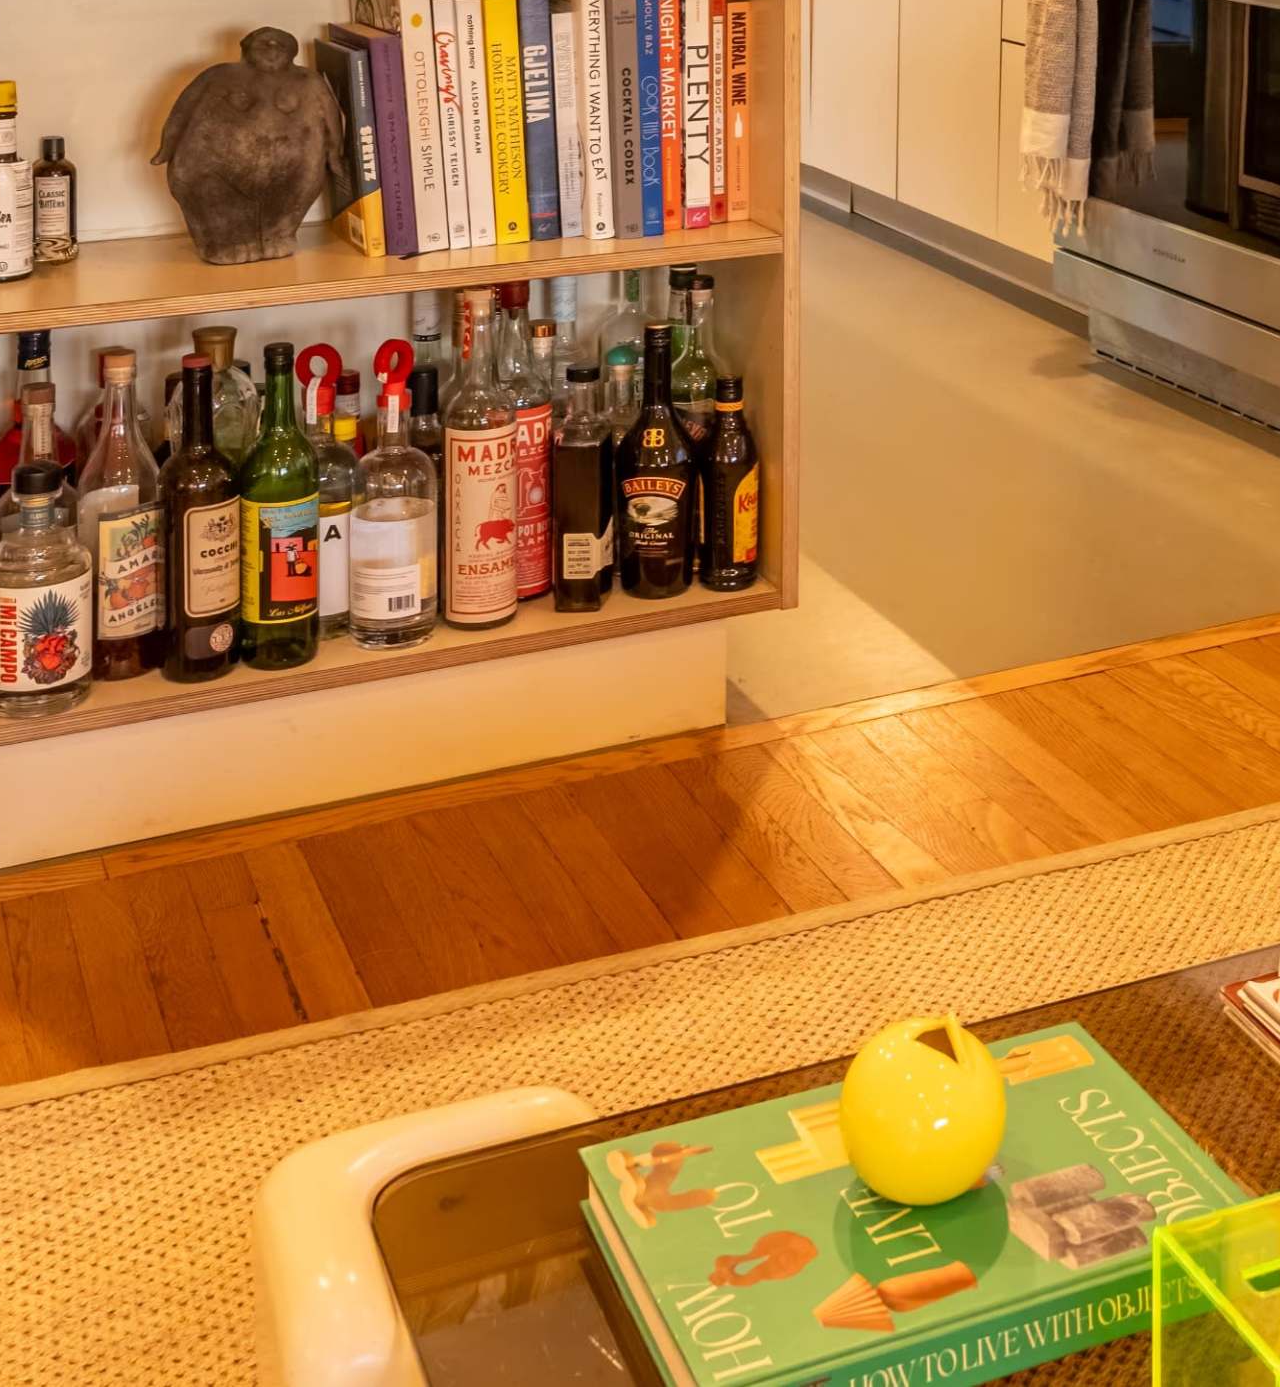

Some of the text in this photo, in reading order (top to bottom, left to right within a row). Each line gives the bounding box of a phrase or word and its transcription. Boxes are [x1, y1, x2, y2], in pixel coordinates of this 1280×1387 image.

[466, 14, 475, 45] nothing
[645, 35, 654, 55] BAZ
[664, 53, 671, 63] +
[523, 44, 551, 124] GJELINA
[731, 12, 747, 107] NATURAL WINE
[415, 51, 436, 192] OTTOLENGHI SIMPLE
[435, 31, 461, 187] Cravings CHRISSY TEIGEN
[471, 80, 482, 154] ALISON ROMAN
[491, 42, 510, 195] HOME STYLE COOKERY
[505, 55, 522, 179] MATTY MATHESON
[589, 92, 601, 134] WANT
[641, 75, 659, 116] COOK
[661, 67, 676, 141] MARKET
[687, 45, 710, 165] PLENTY
[360, 125, 377, 182] SPRITZ
[589, 137, 601, 155] TO
[622, 68, 635, 185] COCKTAIL CODEX
[642, 121, 659, 140] THIS
[715, 128, 723, 173] AMARO
[39, 190, 65, 199] CLASSIC
[387, 111, 399, 174] SNACKY
[394, 181, 404, 231] TUNES
[591, 158, 608, 181] EAT
[39, 199, 65, 209] BITTERS
[457, 439, 516, 463] MADR
[624, 480, 681, 495] BAILEYS
[628, 532, 675, 540] ORIGINAL
[0, 629, 18, 683] CAMPO
[705, 1181, 773, 1238] TO
[839, 1187, 942, 1268] LIVE
[667, 1281, 773, 1382] HOW
[920, 1348, 958, 1378] TO
[960, 1326, 1022, 1372] LIVE
[1023, 1302, 1095, 1349] WITH
